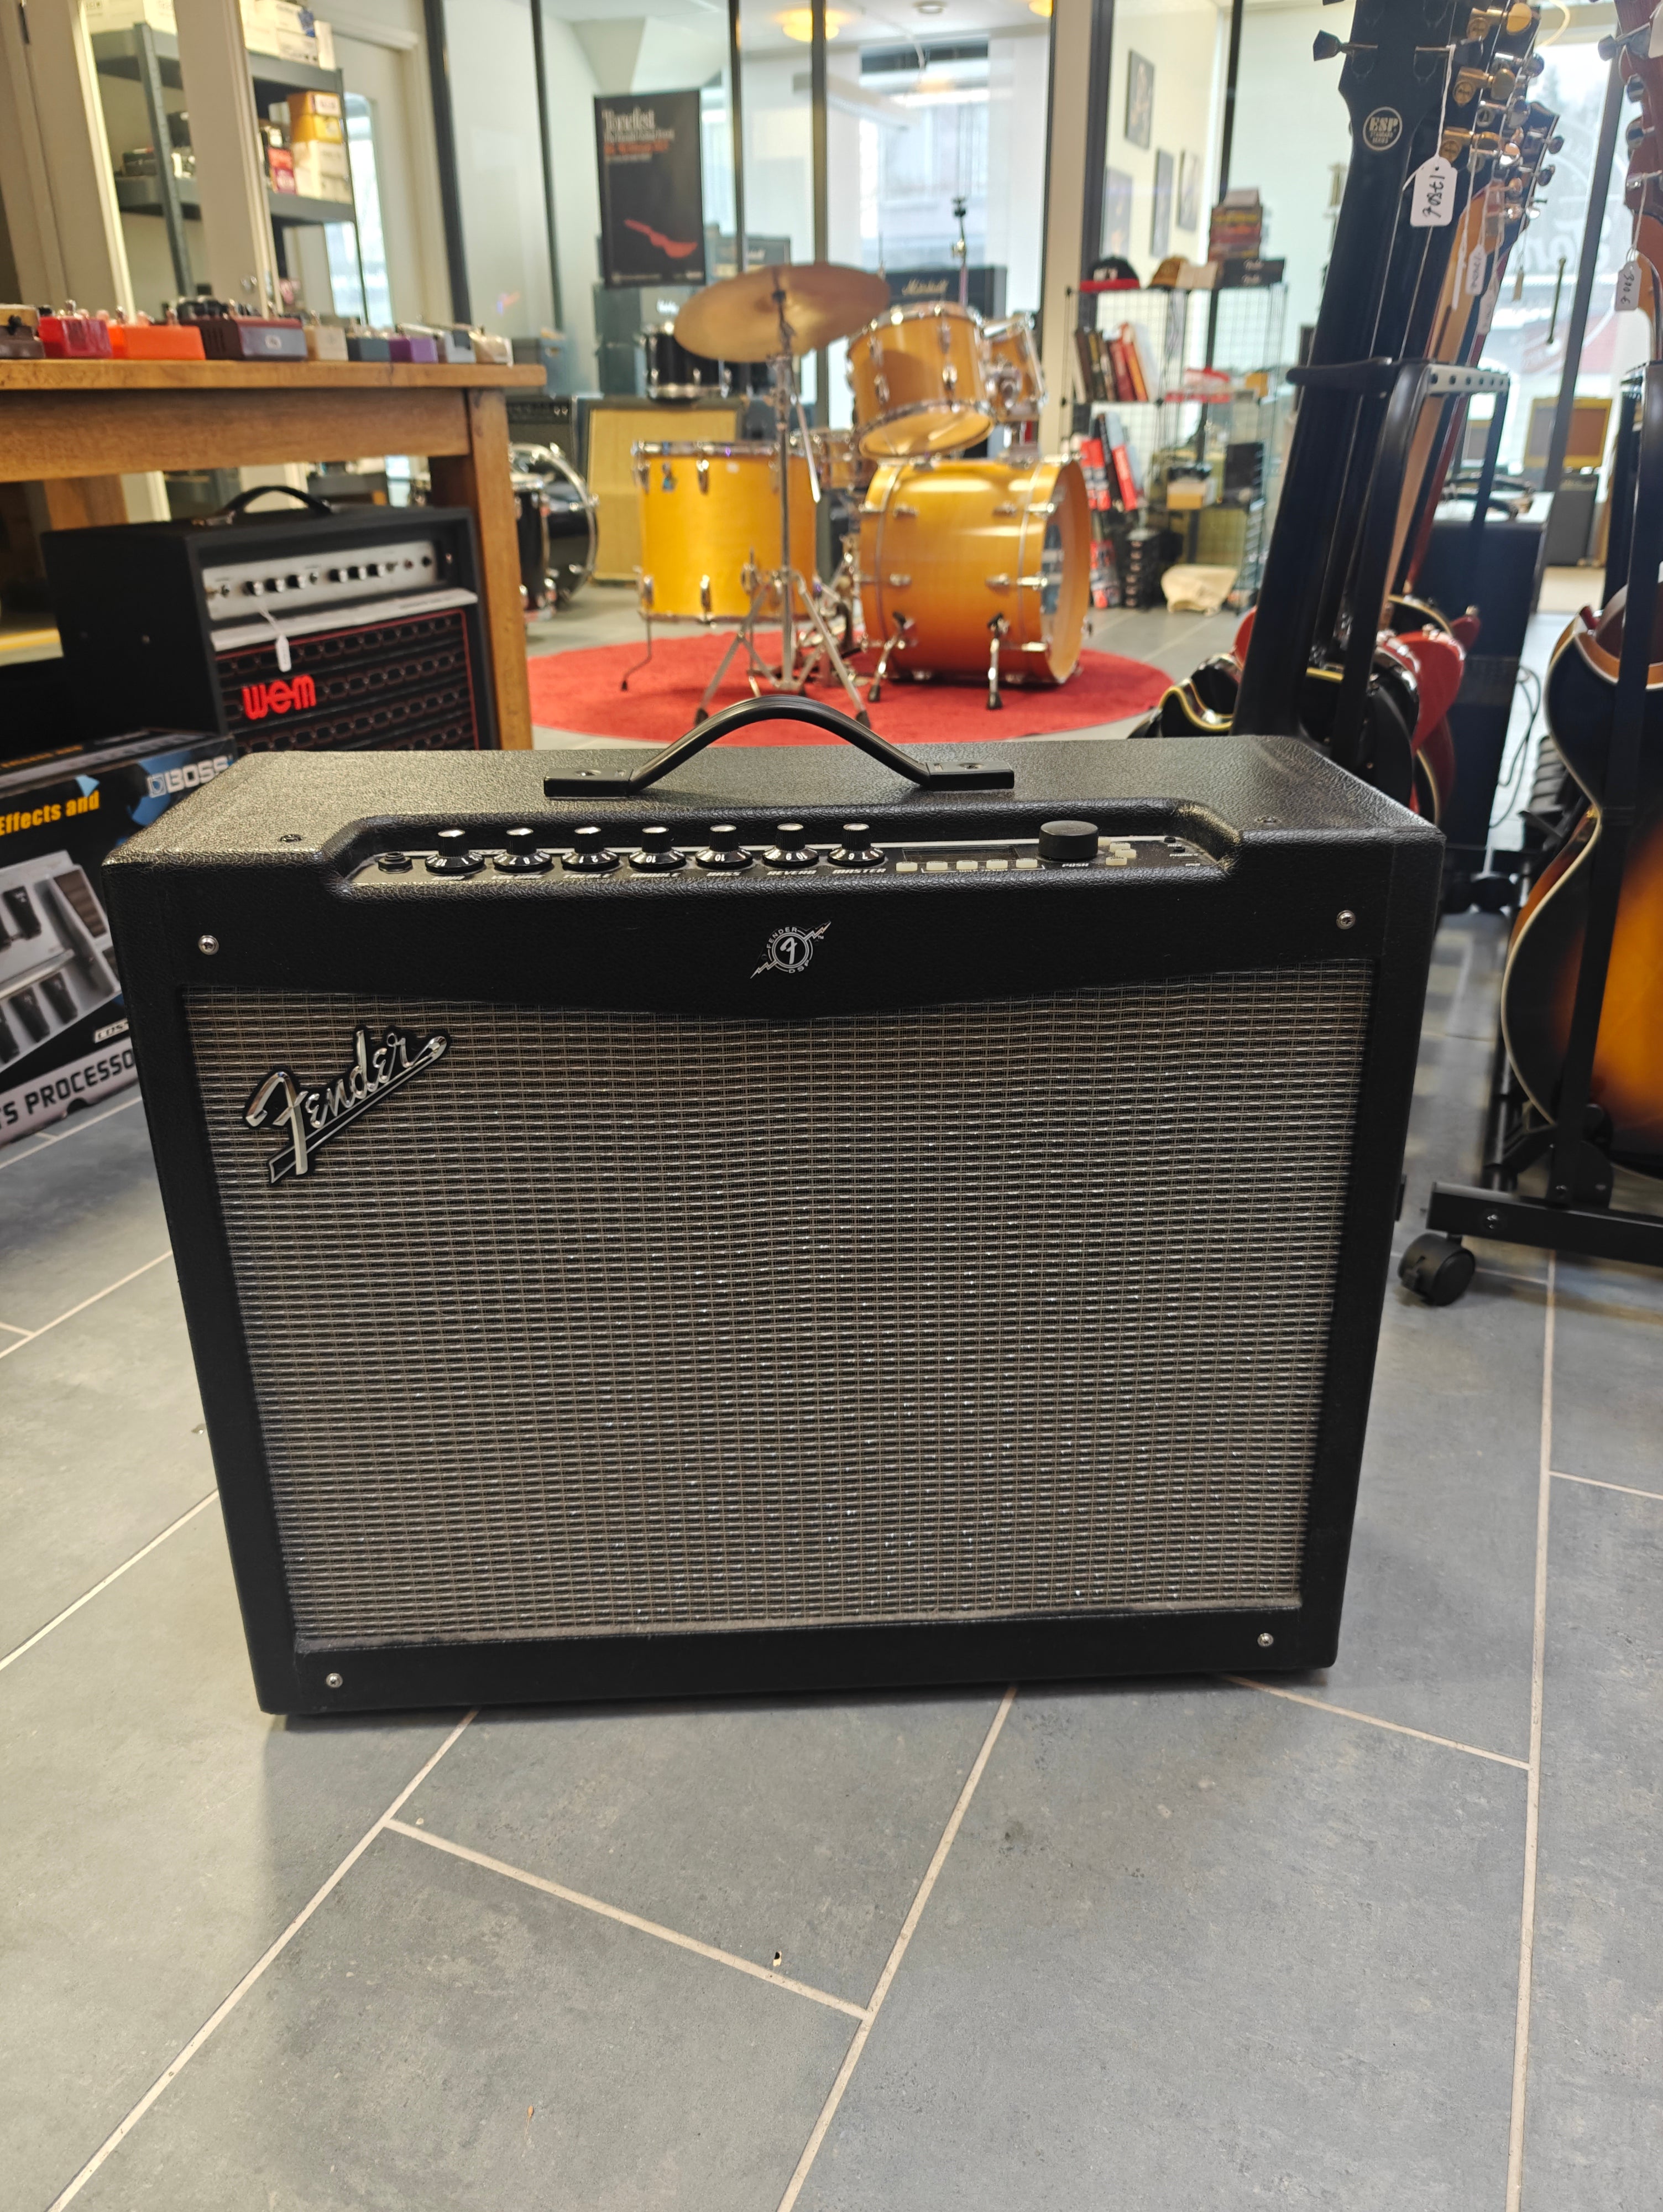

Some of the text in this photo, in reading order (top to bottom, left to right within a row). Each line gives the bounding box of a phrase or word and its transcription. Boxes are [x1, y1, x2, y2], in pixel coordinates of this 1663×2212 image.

[1369, 117, 1399, 132] ESP
[166, 755, 229, 793] BOSS
[0, 790, 100, 837] Effects and
[646, 855, 656, 863] 10
[714, 853, 725, 862] 10
[766, 926, 797, 949] FENDER
[788, 959, 810, 973] DSP
[245, 1030, 447, 1183] Fender
